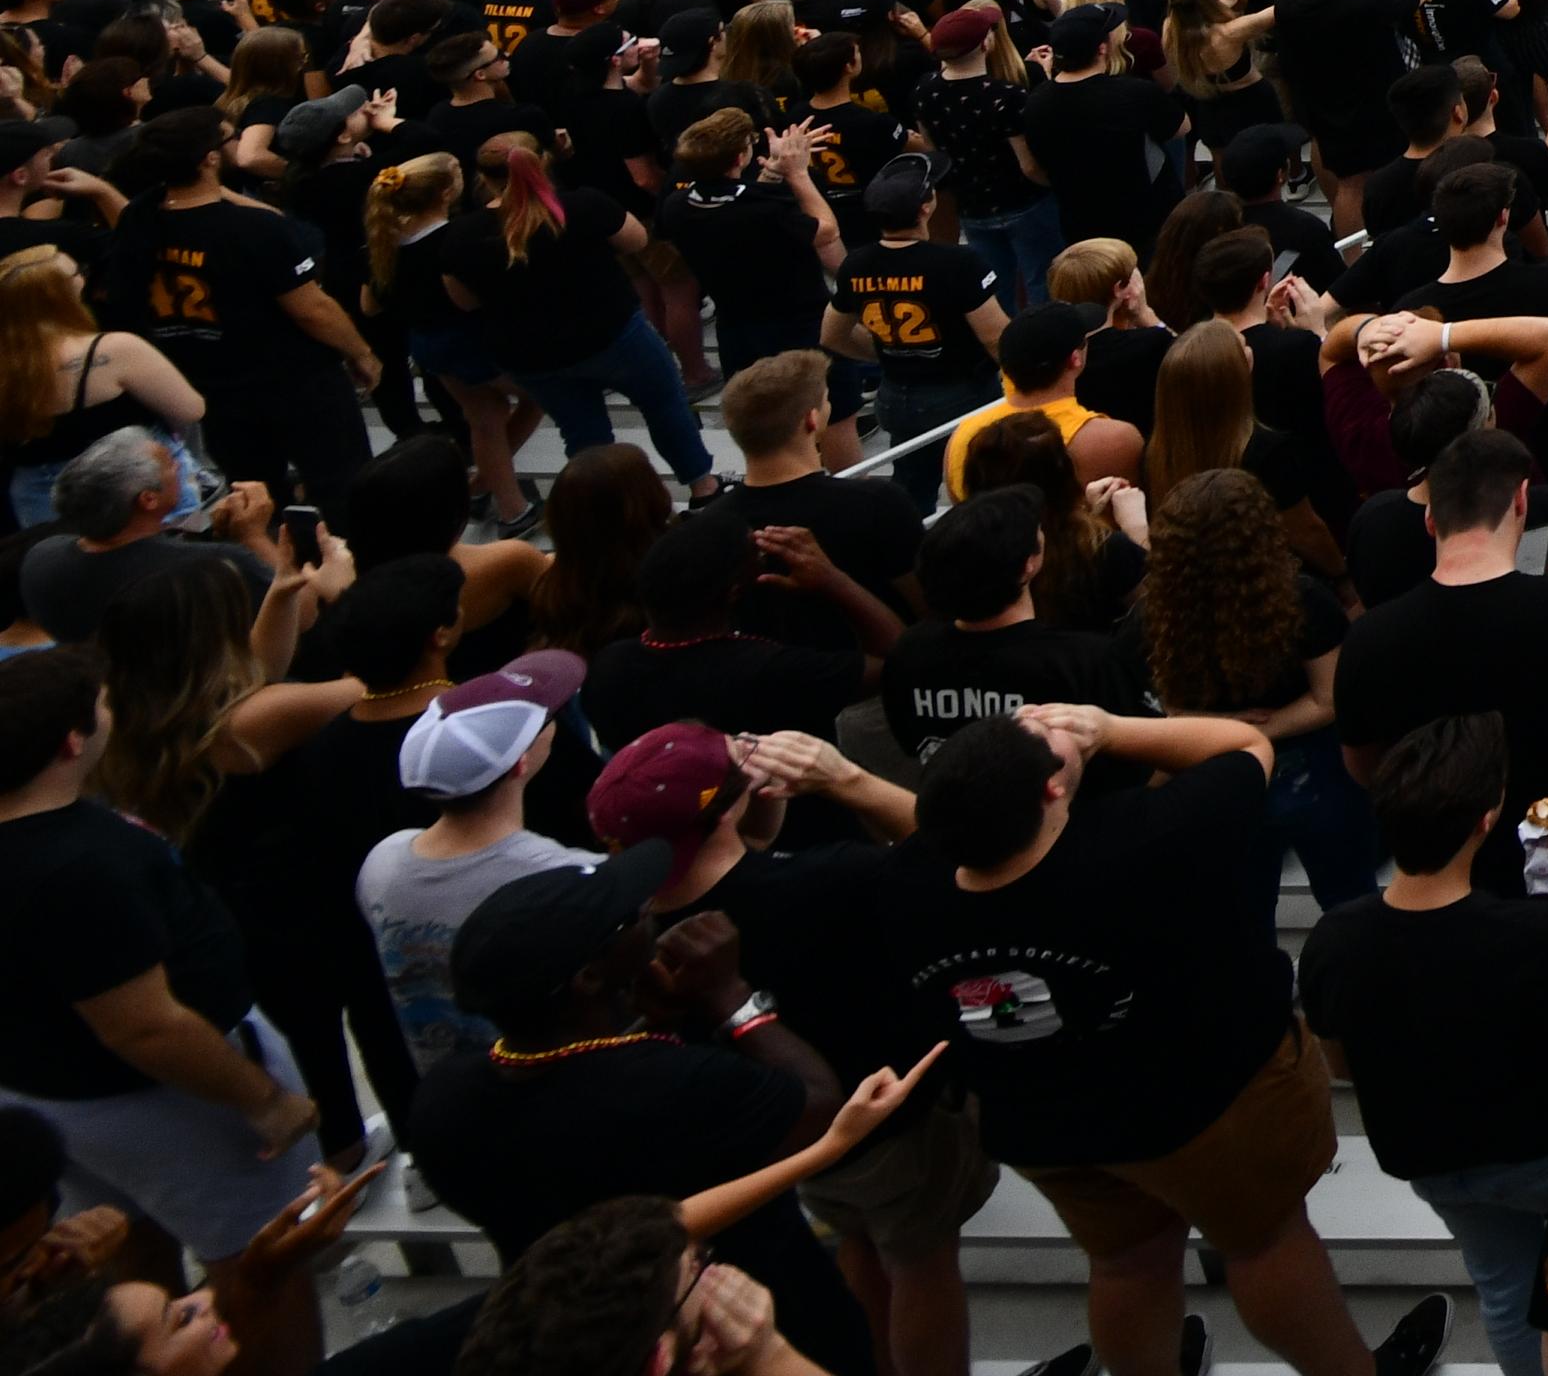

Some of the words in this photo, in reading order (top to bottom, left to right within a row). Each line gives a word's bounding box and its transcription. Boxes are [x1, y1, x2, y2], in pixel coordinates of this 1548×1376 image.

[485, 2, 534, 18] TILLMAN
[851, 275, 924, 294] TILLMAN
[862, 300, 937, 345] 42
